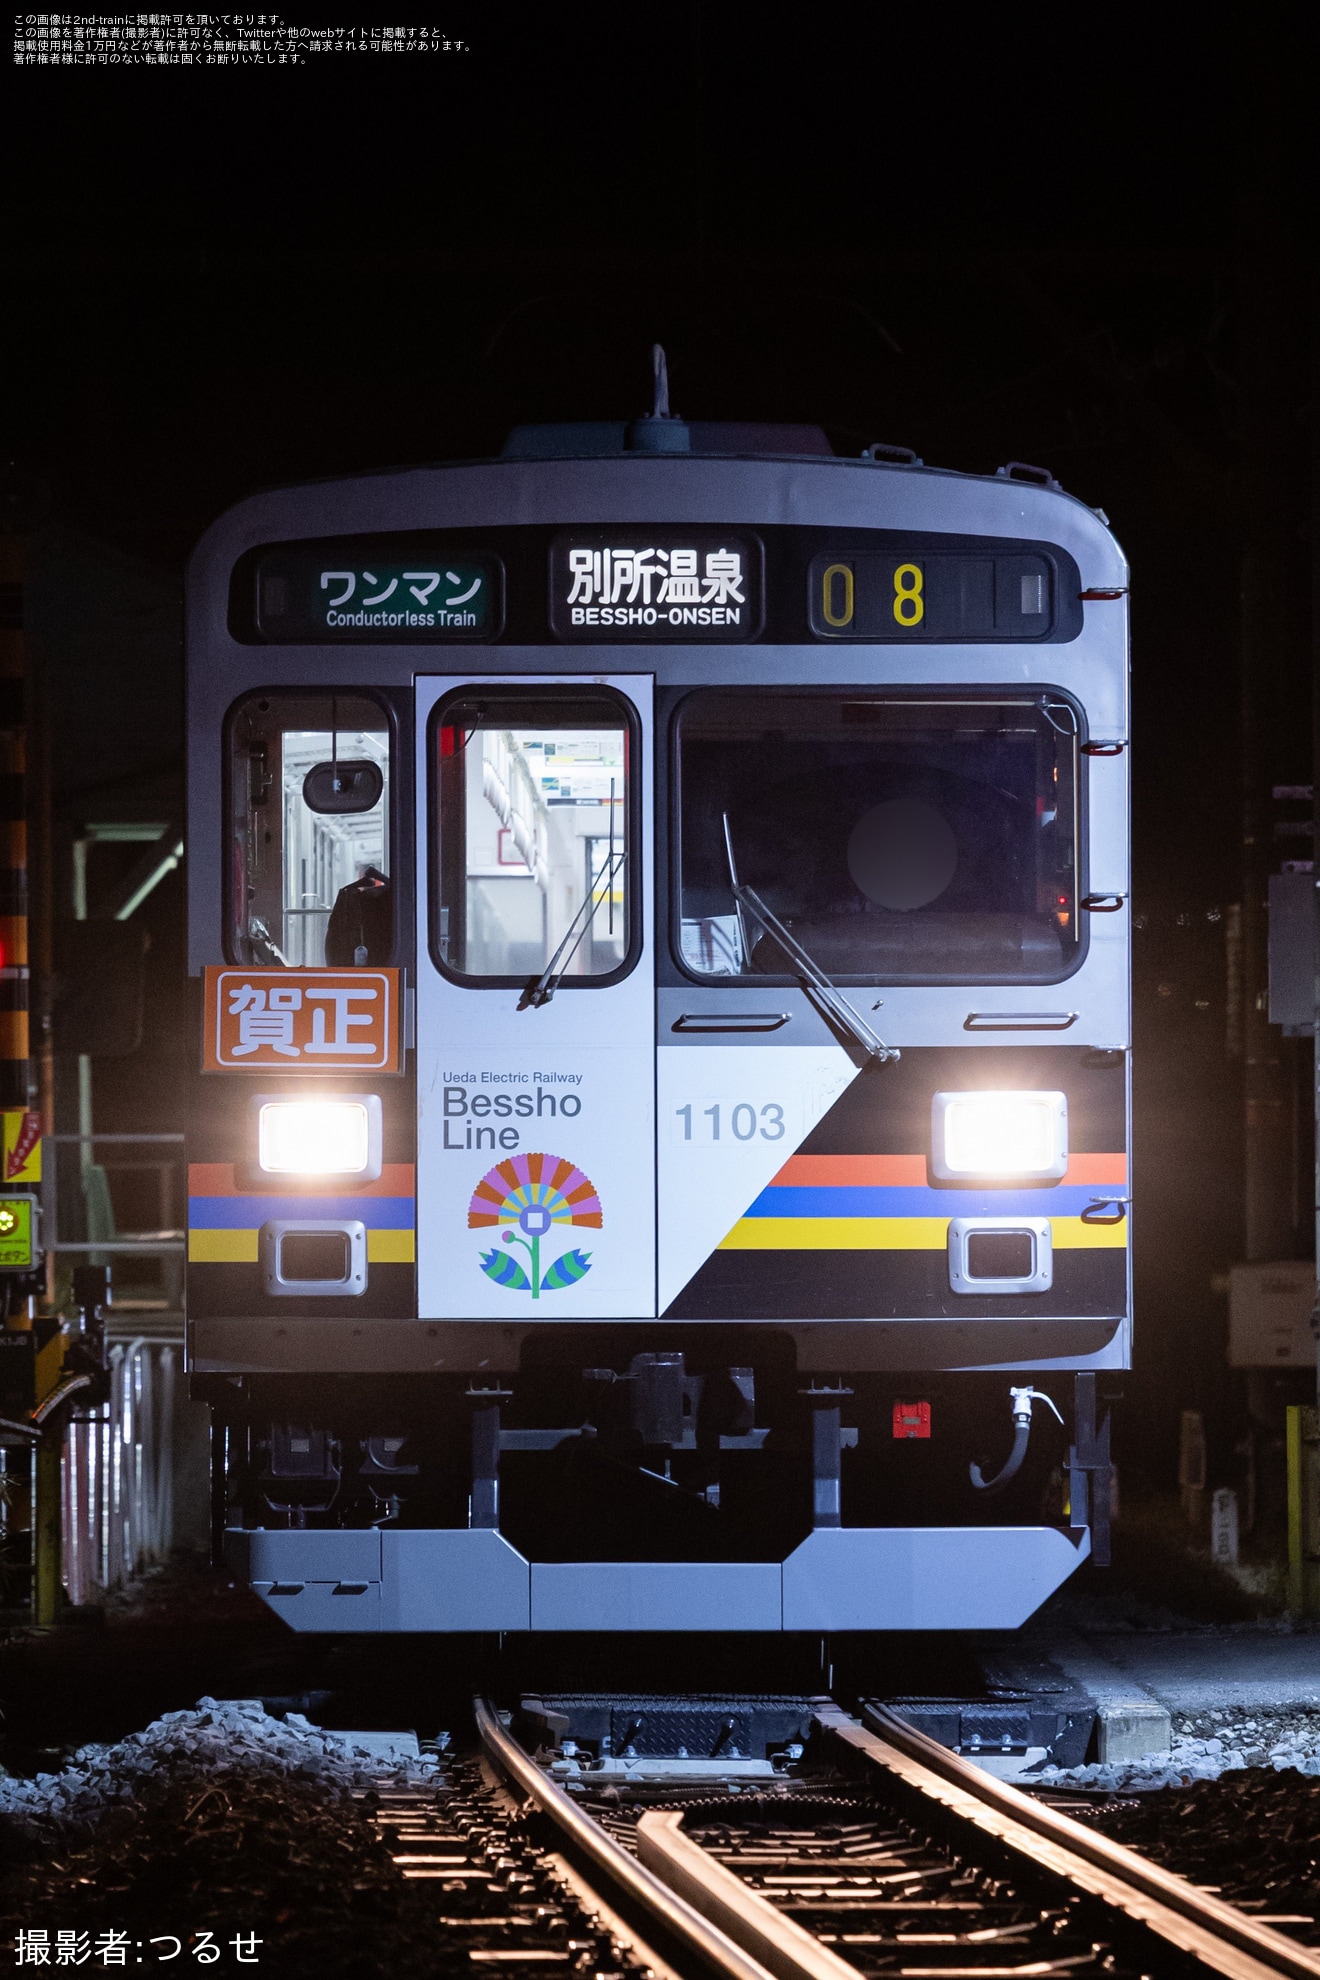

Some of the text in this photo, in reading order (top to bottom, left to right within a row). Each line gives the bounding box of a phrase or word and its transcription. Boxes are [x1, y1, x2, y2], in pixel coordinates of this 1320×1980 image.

[320, 571, 482, 606] ワンマン
[567, 548, 745, 605] 別所温泉
[326, 609, 476, 627] Conductorless Train
[571, 607, 740, 626] BESSHO-ONSEN
[228, 984, 378, 1058] 賀正
[443, 1072, 583, 1085] Ueda Electric Railway
[443, 1087, 582, 1117] Bessho
[443, 1120, 520, 1150] Line
[675, 1103, 786, 1141] 1103
